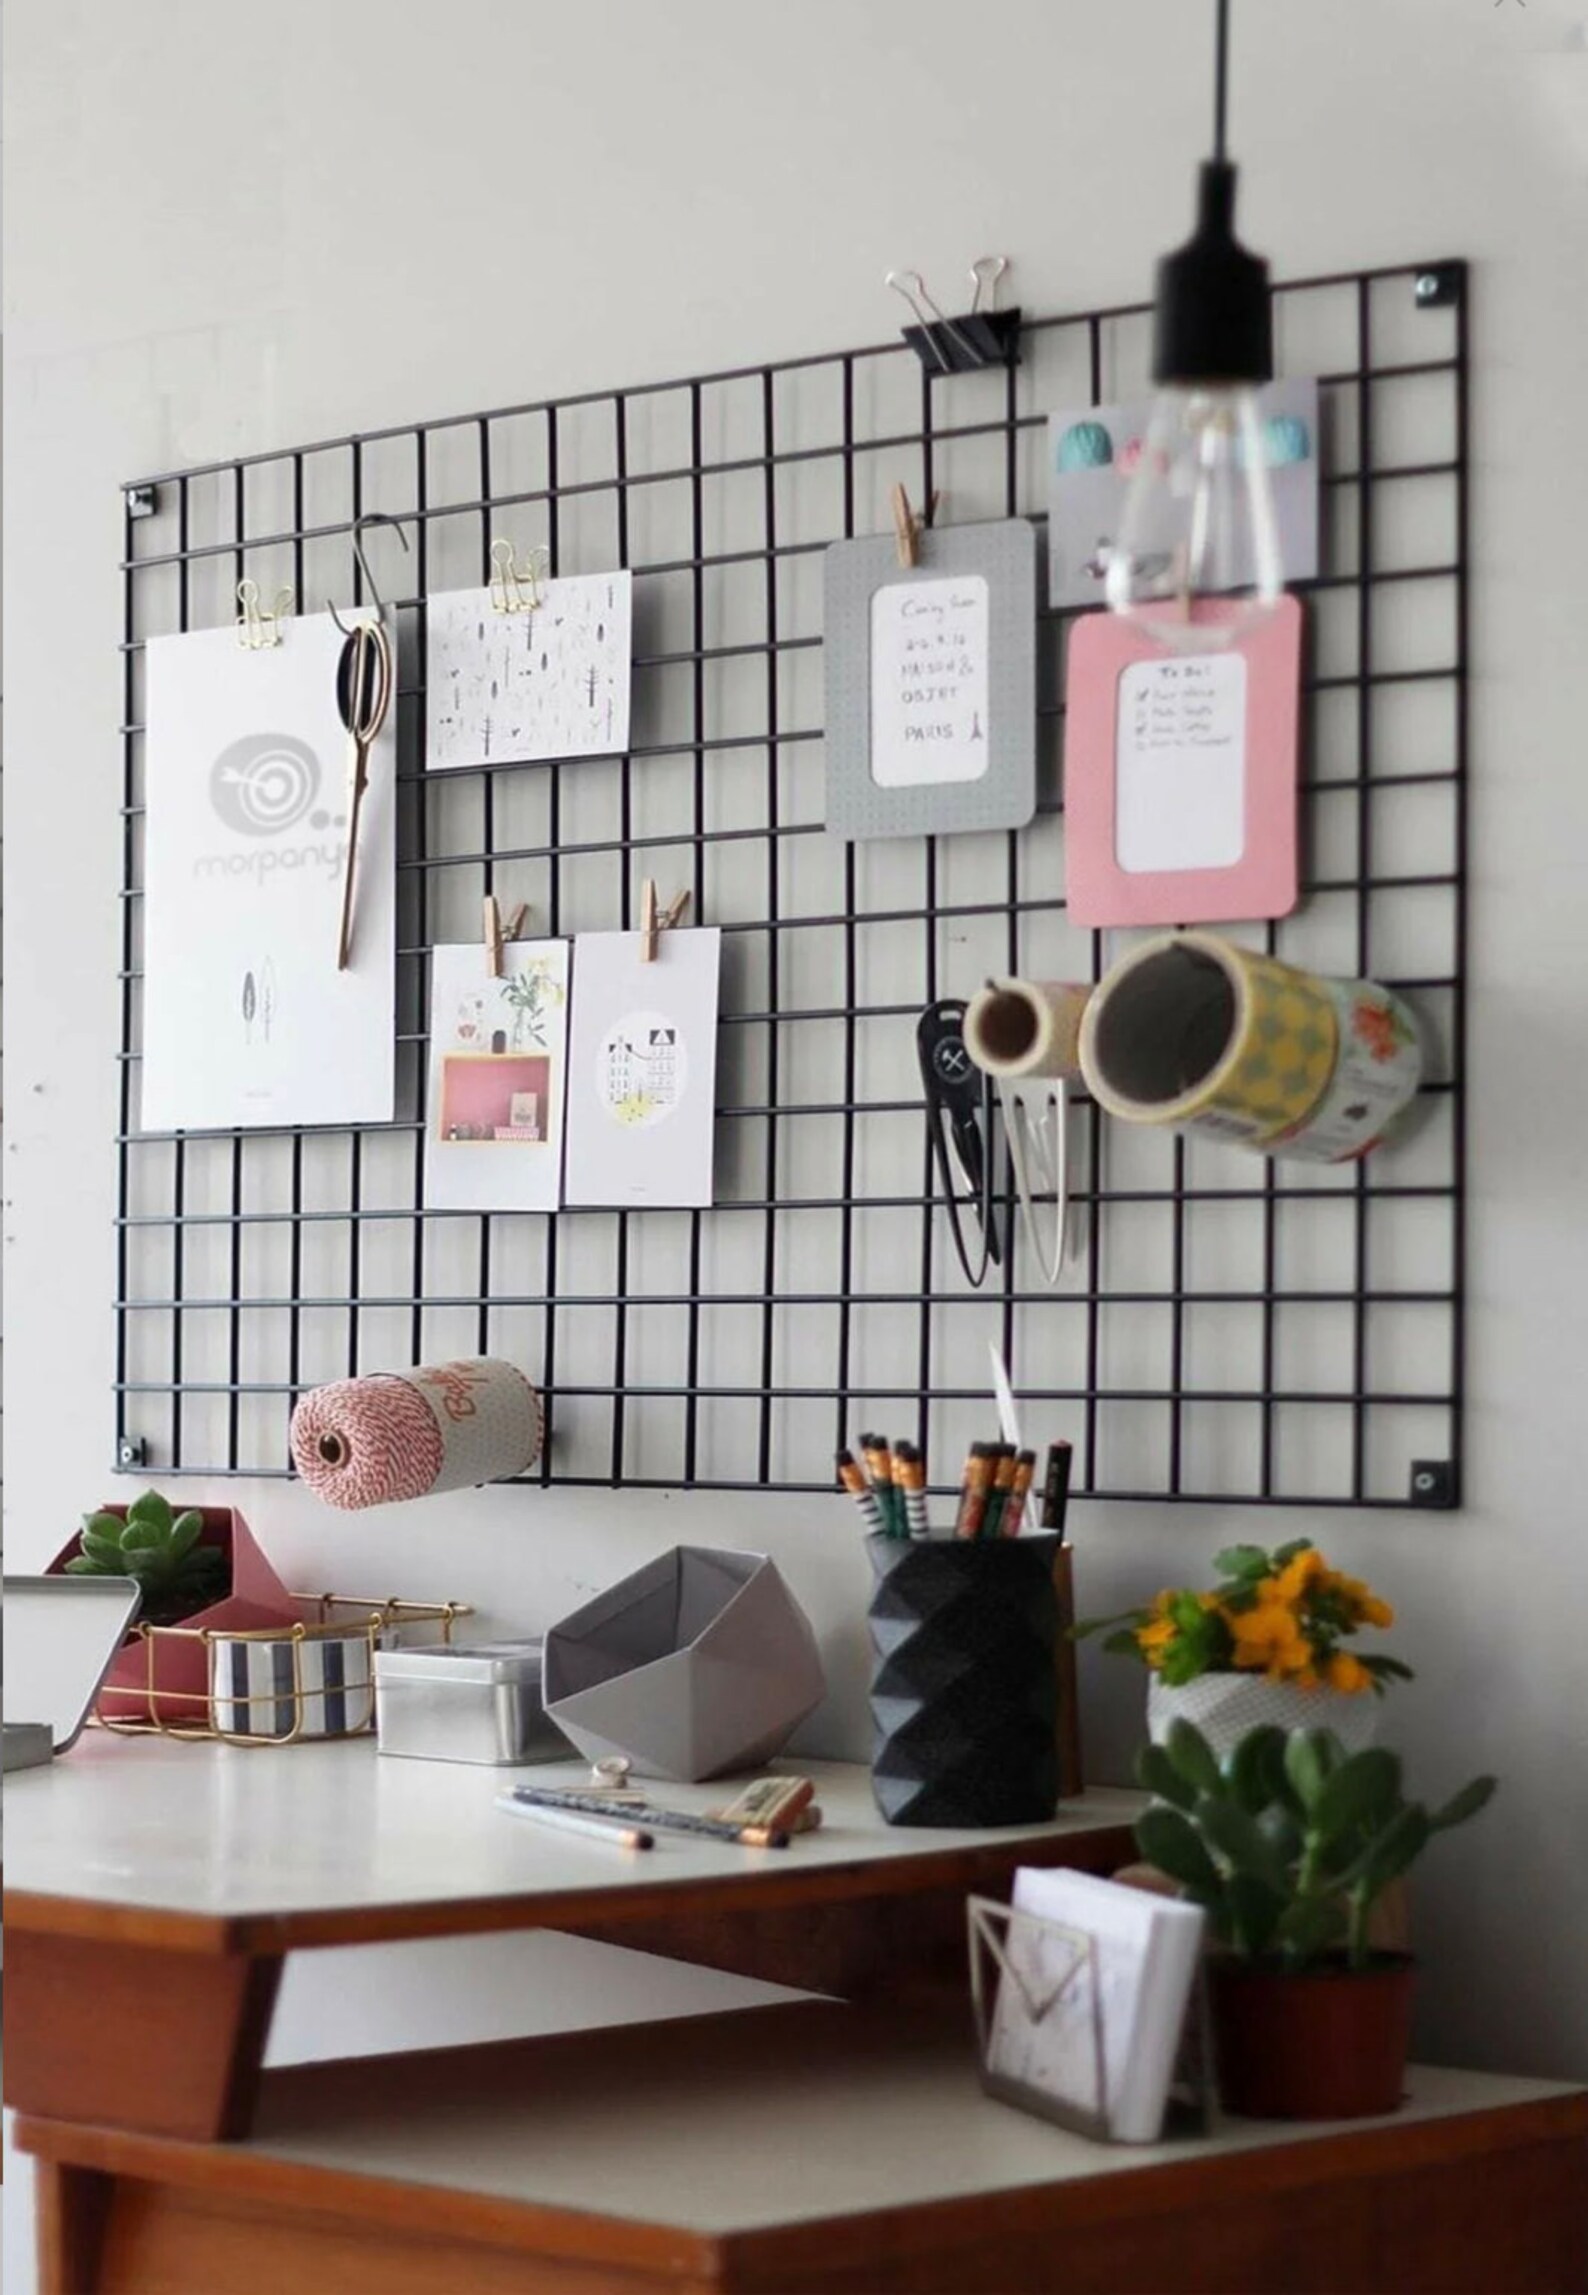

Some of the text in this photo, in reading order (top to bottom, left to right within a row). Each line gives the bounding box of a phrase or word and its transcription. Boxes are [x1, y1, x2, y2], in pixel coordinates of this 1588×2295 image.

[901, 686, 958, 705] OBJET
[904, 723, 954, 742] PARIS
[193, 842, 363, 888] morpany
